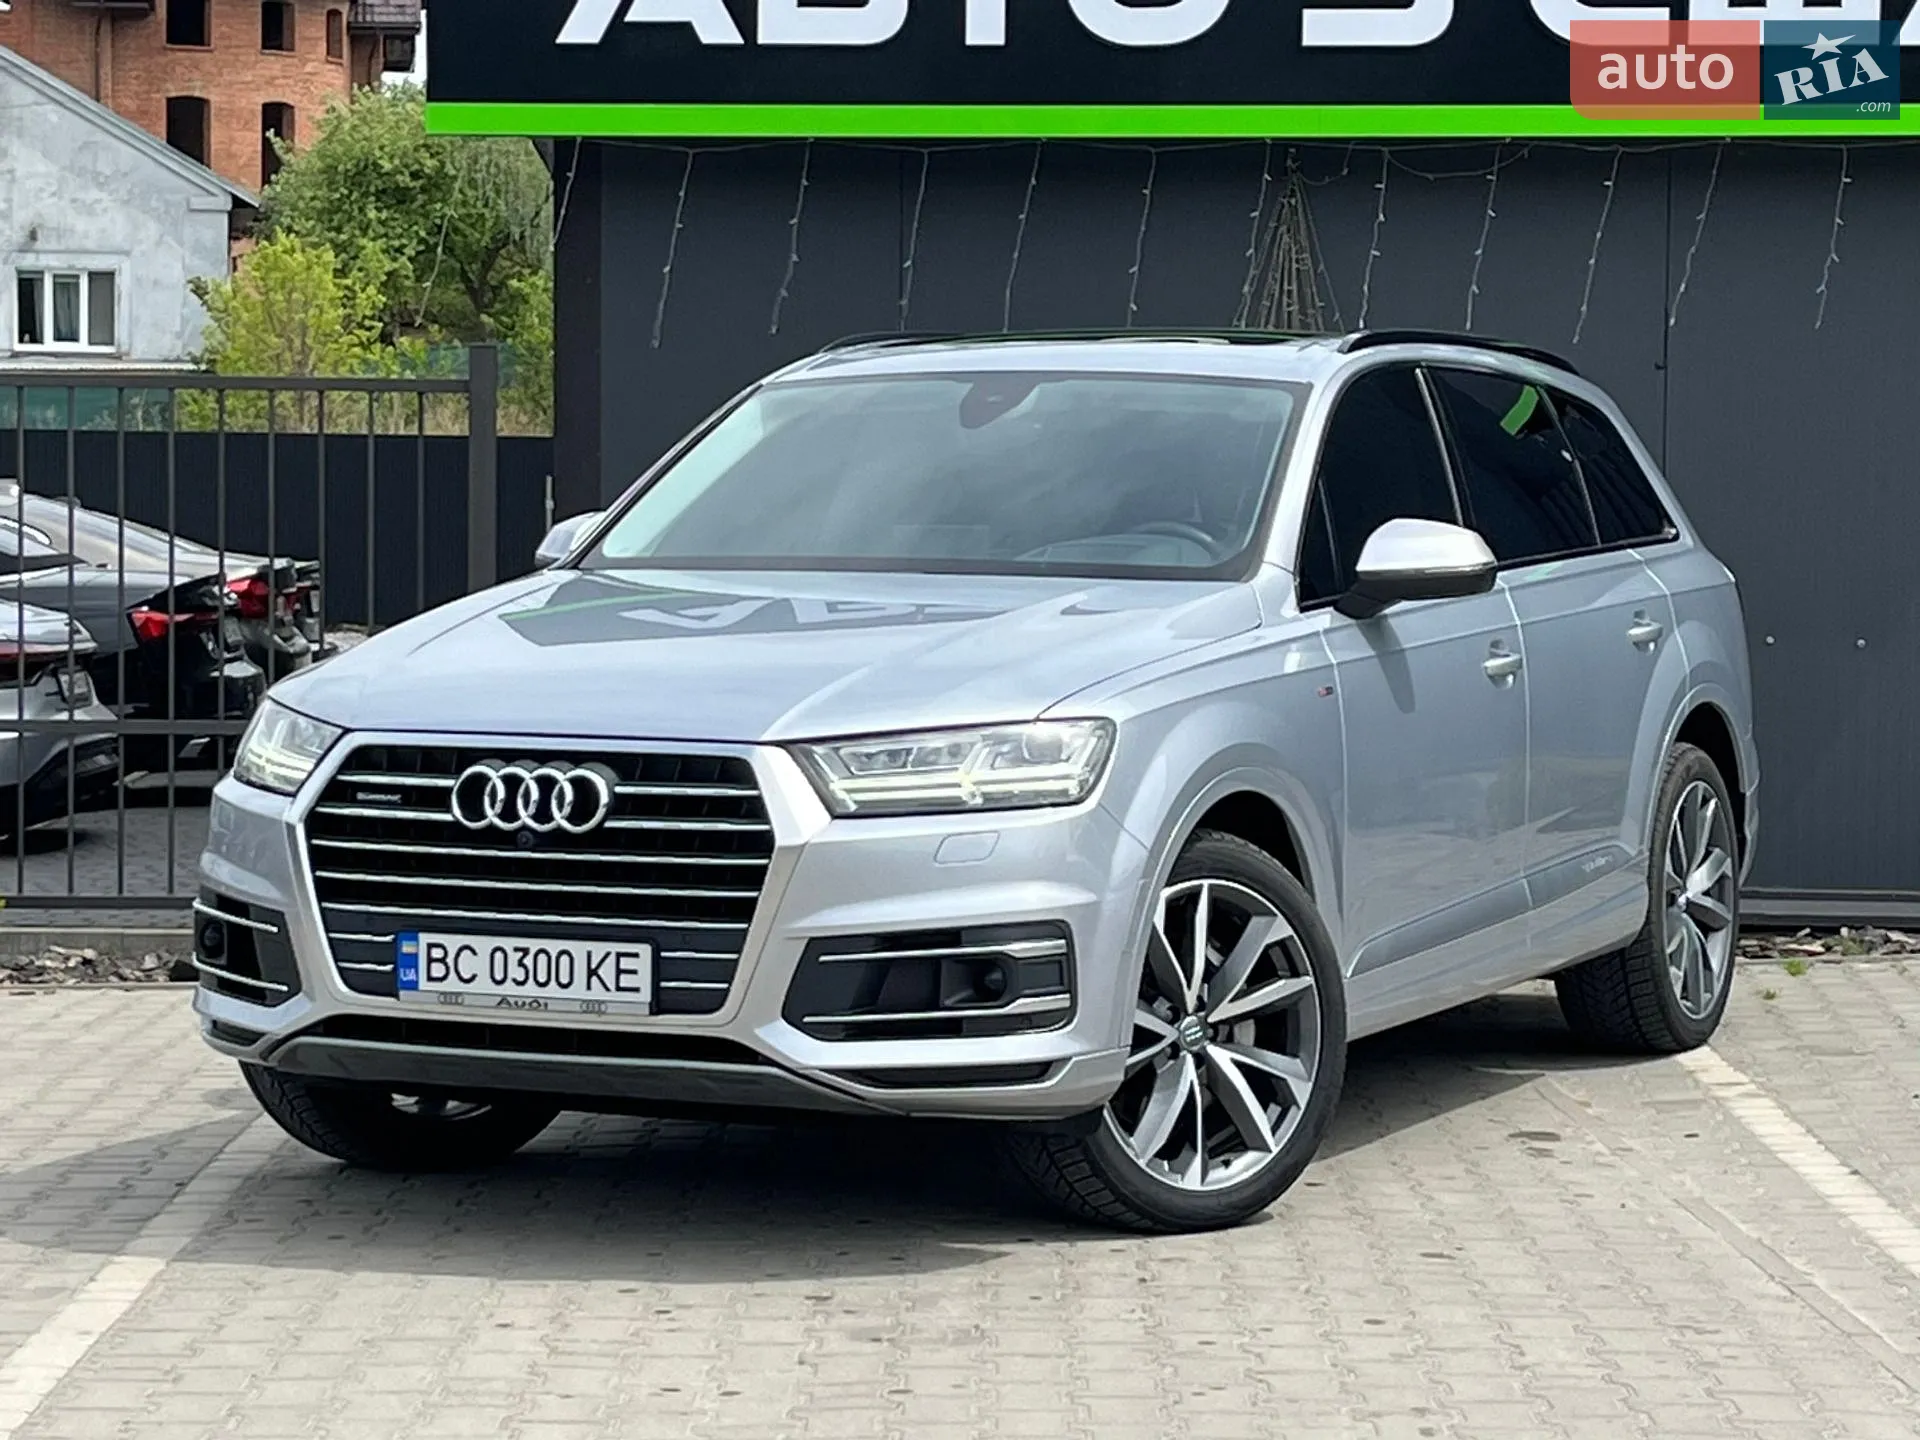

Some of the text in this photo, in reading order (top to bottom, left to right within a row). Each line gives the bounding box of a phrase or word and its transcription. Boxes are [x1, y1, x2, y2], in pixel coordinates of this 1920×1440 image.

[400, 967, 417, 982] UA
[426, 942, 641, 993] BC 0300 KE
